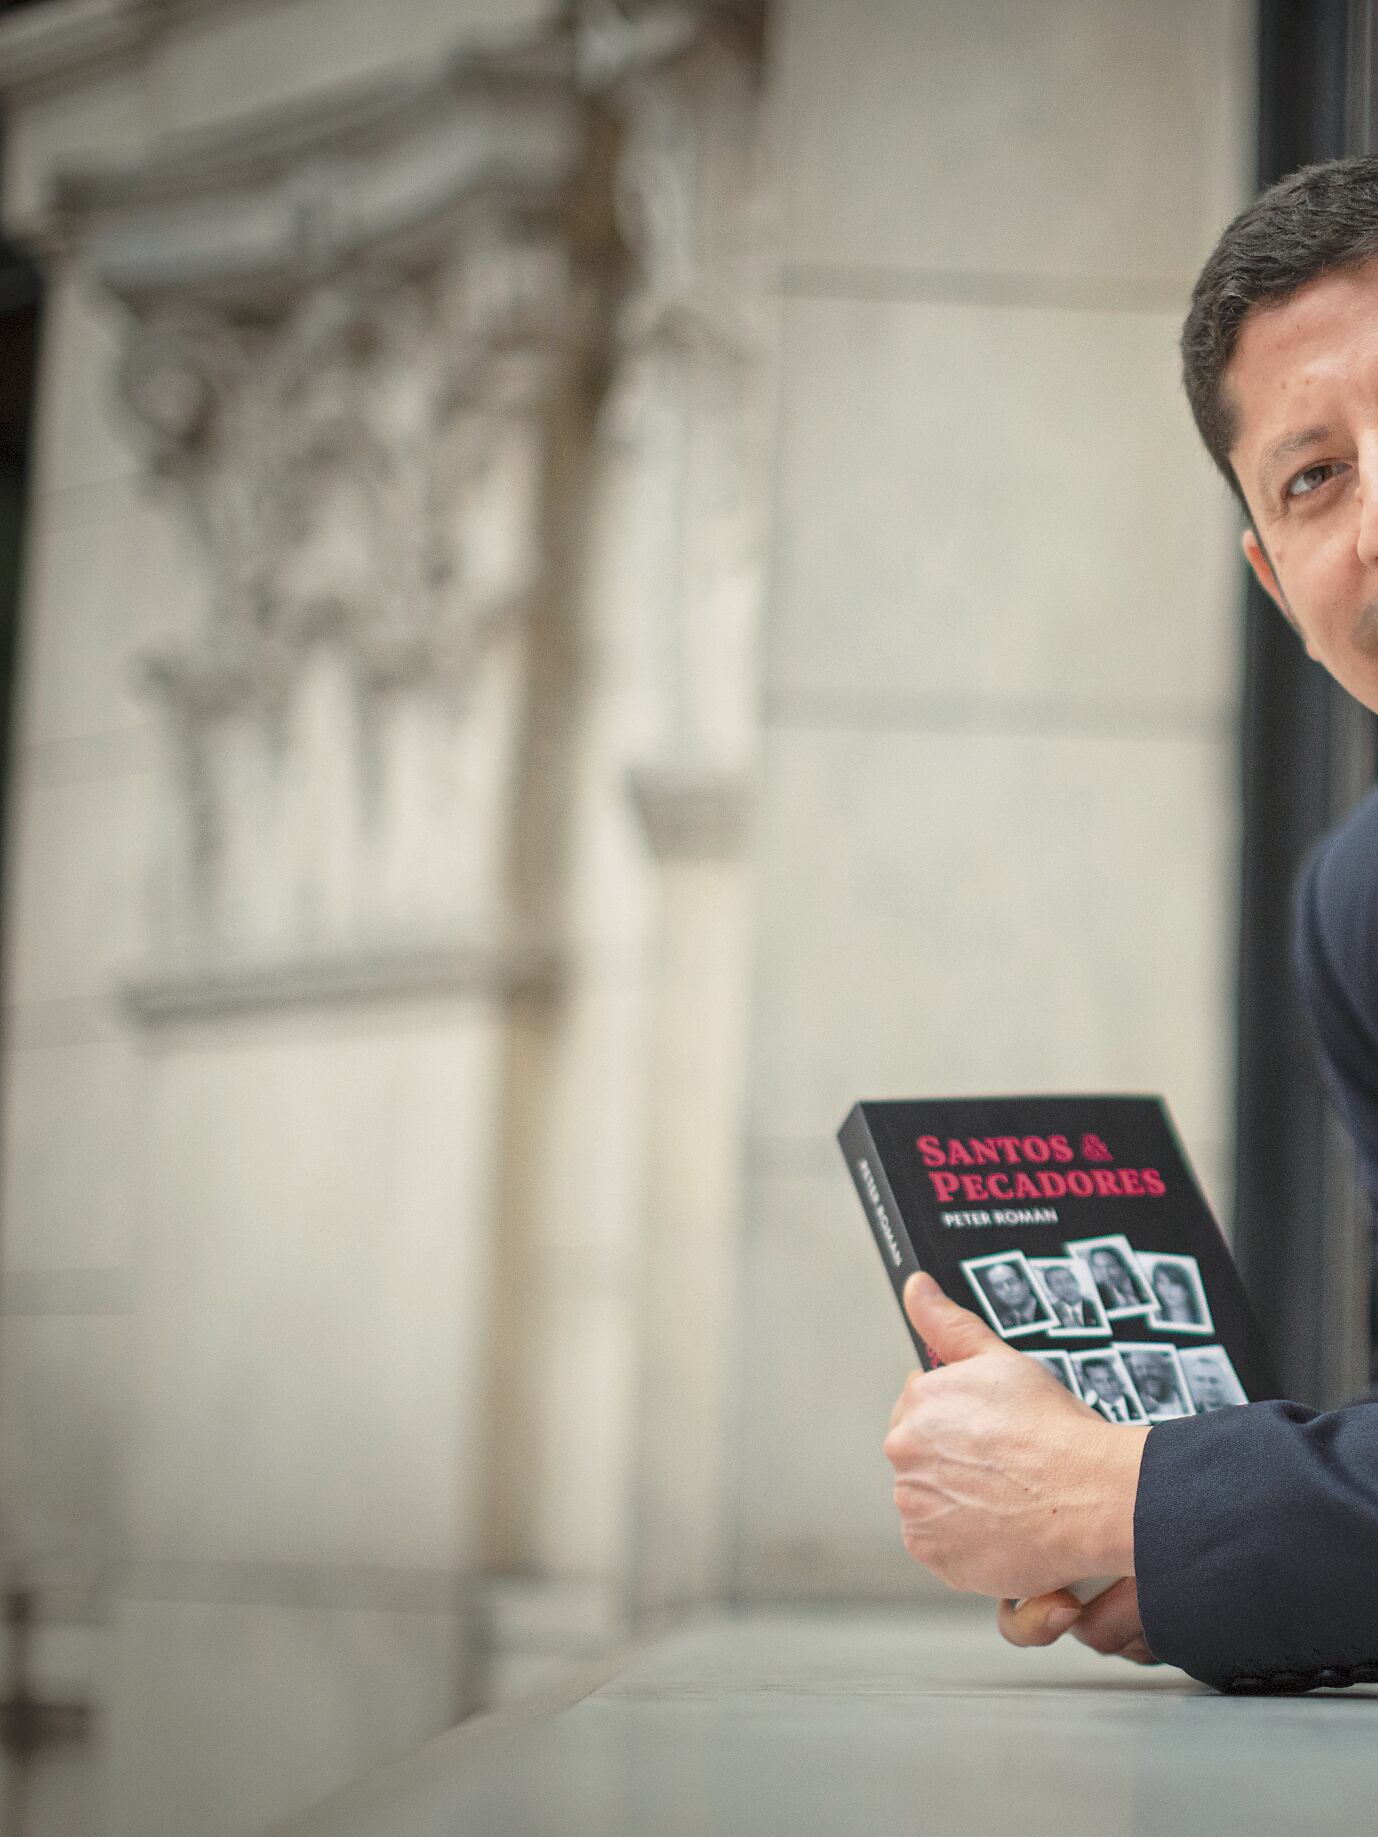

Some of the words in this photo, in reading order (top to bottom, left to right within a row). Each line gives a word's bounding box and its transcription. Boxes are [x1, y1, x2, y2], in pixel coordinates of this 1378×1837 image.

[916, 1134, 1074, 1167] SANTOS
[1081, 1132, 1114, 1163] &
[928, 1167, 1167, 1202] PECADORES
[942, 1209, 992, 1229] PETER
[992, 1207, 1060, 1226] ROMAN
